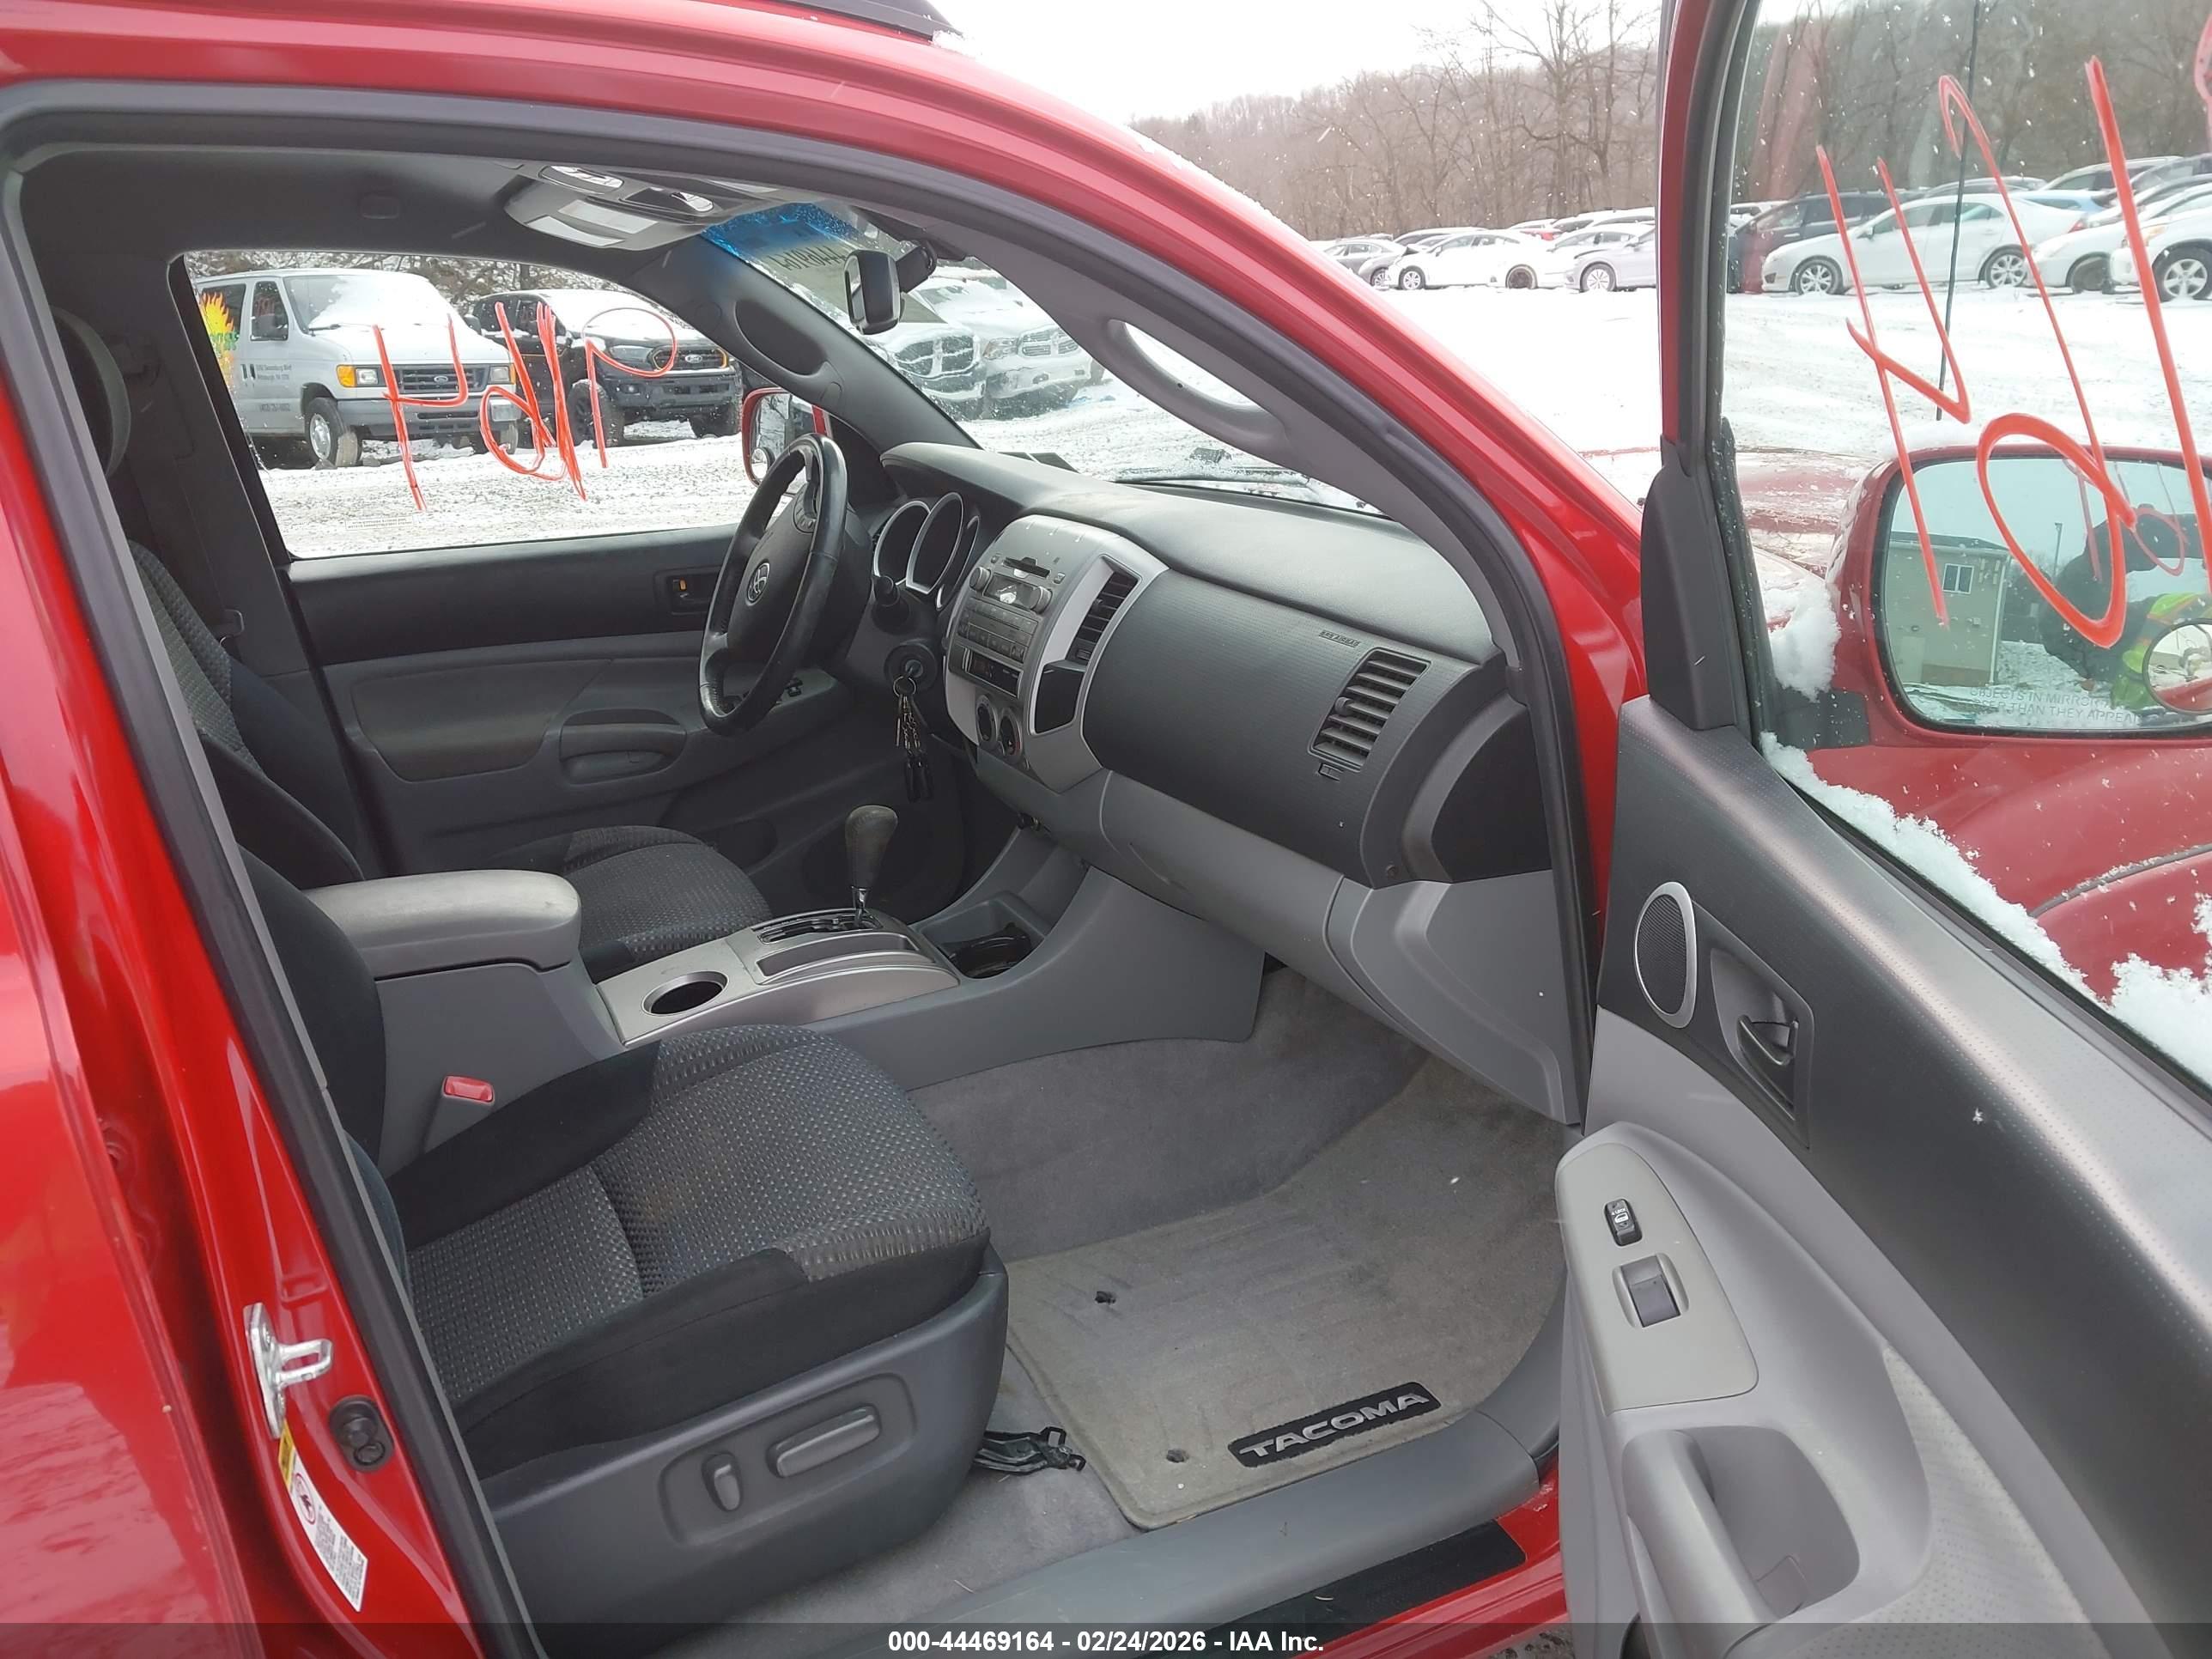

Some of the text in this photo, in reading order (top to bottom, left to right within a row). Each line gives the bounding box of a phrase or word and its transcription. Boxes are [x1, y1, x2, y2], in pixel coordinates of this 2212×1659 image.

[1970, 686, 2025, 701] OBJECTS
[2029, 691, 2042, 702] IN
[2046, 693, 2098, 708] MIRROR
[2010, 702, 2045, 714] THAN
[2050, 706, 2083, 719] THEY
[1239, 1392, 1430, 1457] TACOMA
